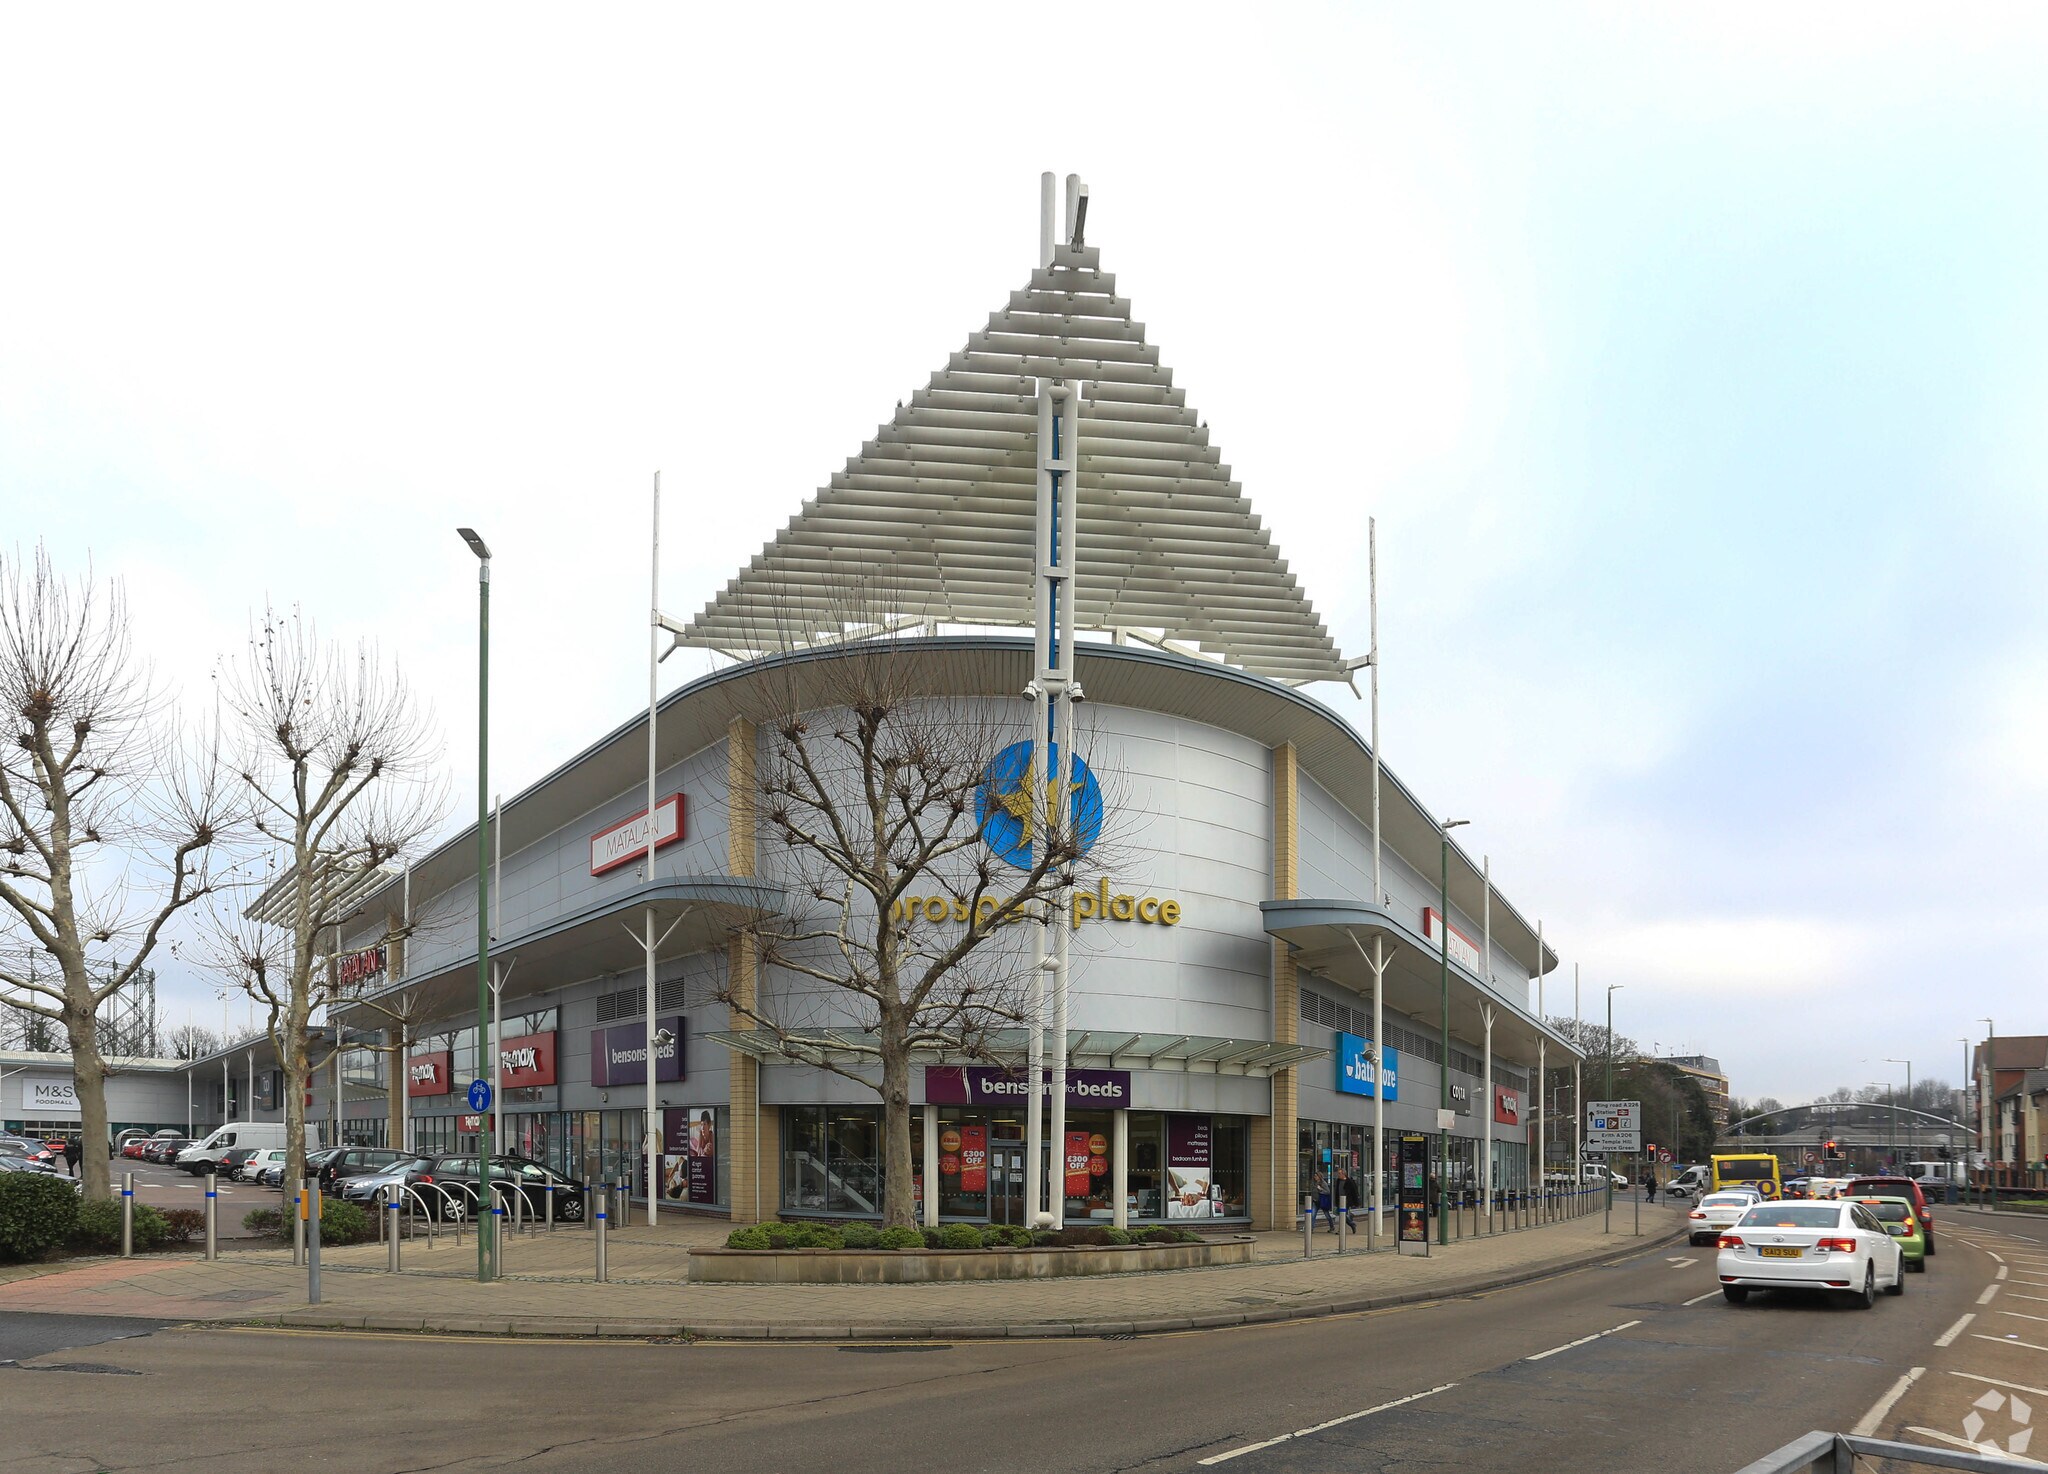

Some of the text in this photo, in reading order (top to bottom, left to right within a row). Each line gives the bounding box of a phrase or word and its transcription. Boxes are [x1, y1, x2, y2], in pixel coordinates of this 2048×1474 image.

[606, 815, 659, 857] MATALAN
[1073, 876, 1182, 929] place
[611, 1048, 647, 1064] bensons
[1354, 1054, 1396, 1088] bathore
[35, 1085, 73, 1098] M&S
[1077, 1080, 1123, 1098] beds
[1452, 1085, 1466, 1101] COSTA
[1067, 1155, 1088, 1163] £300
[1764, 1248, 1799, 1256] SA13 SUU
